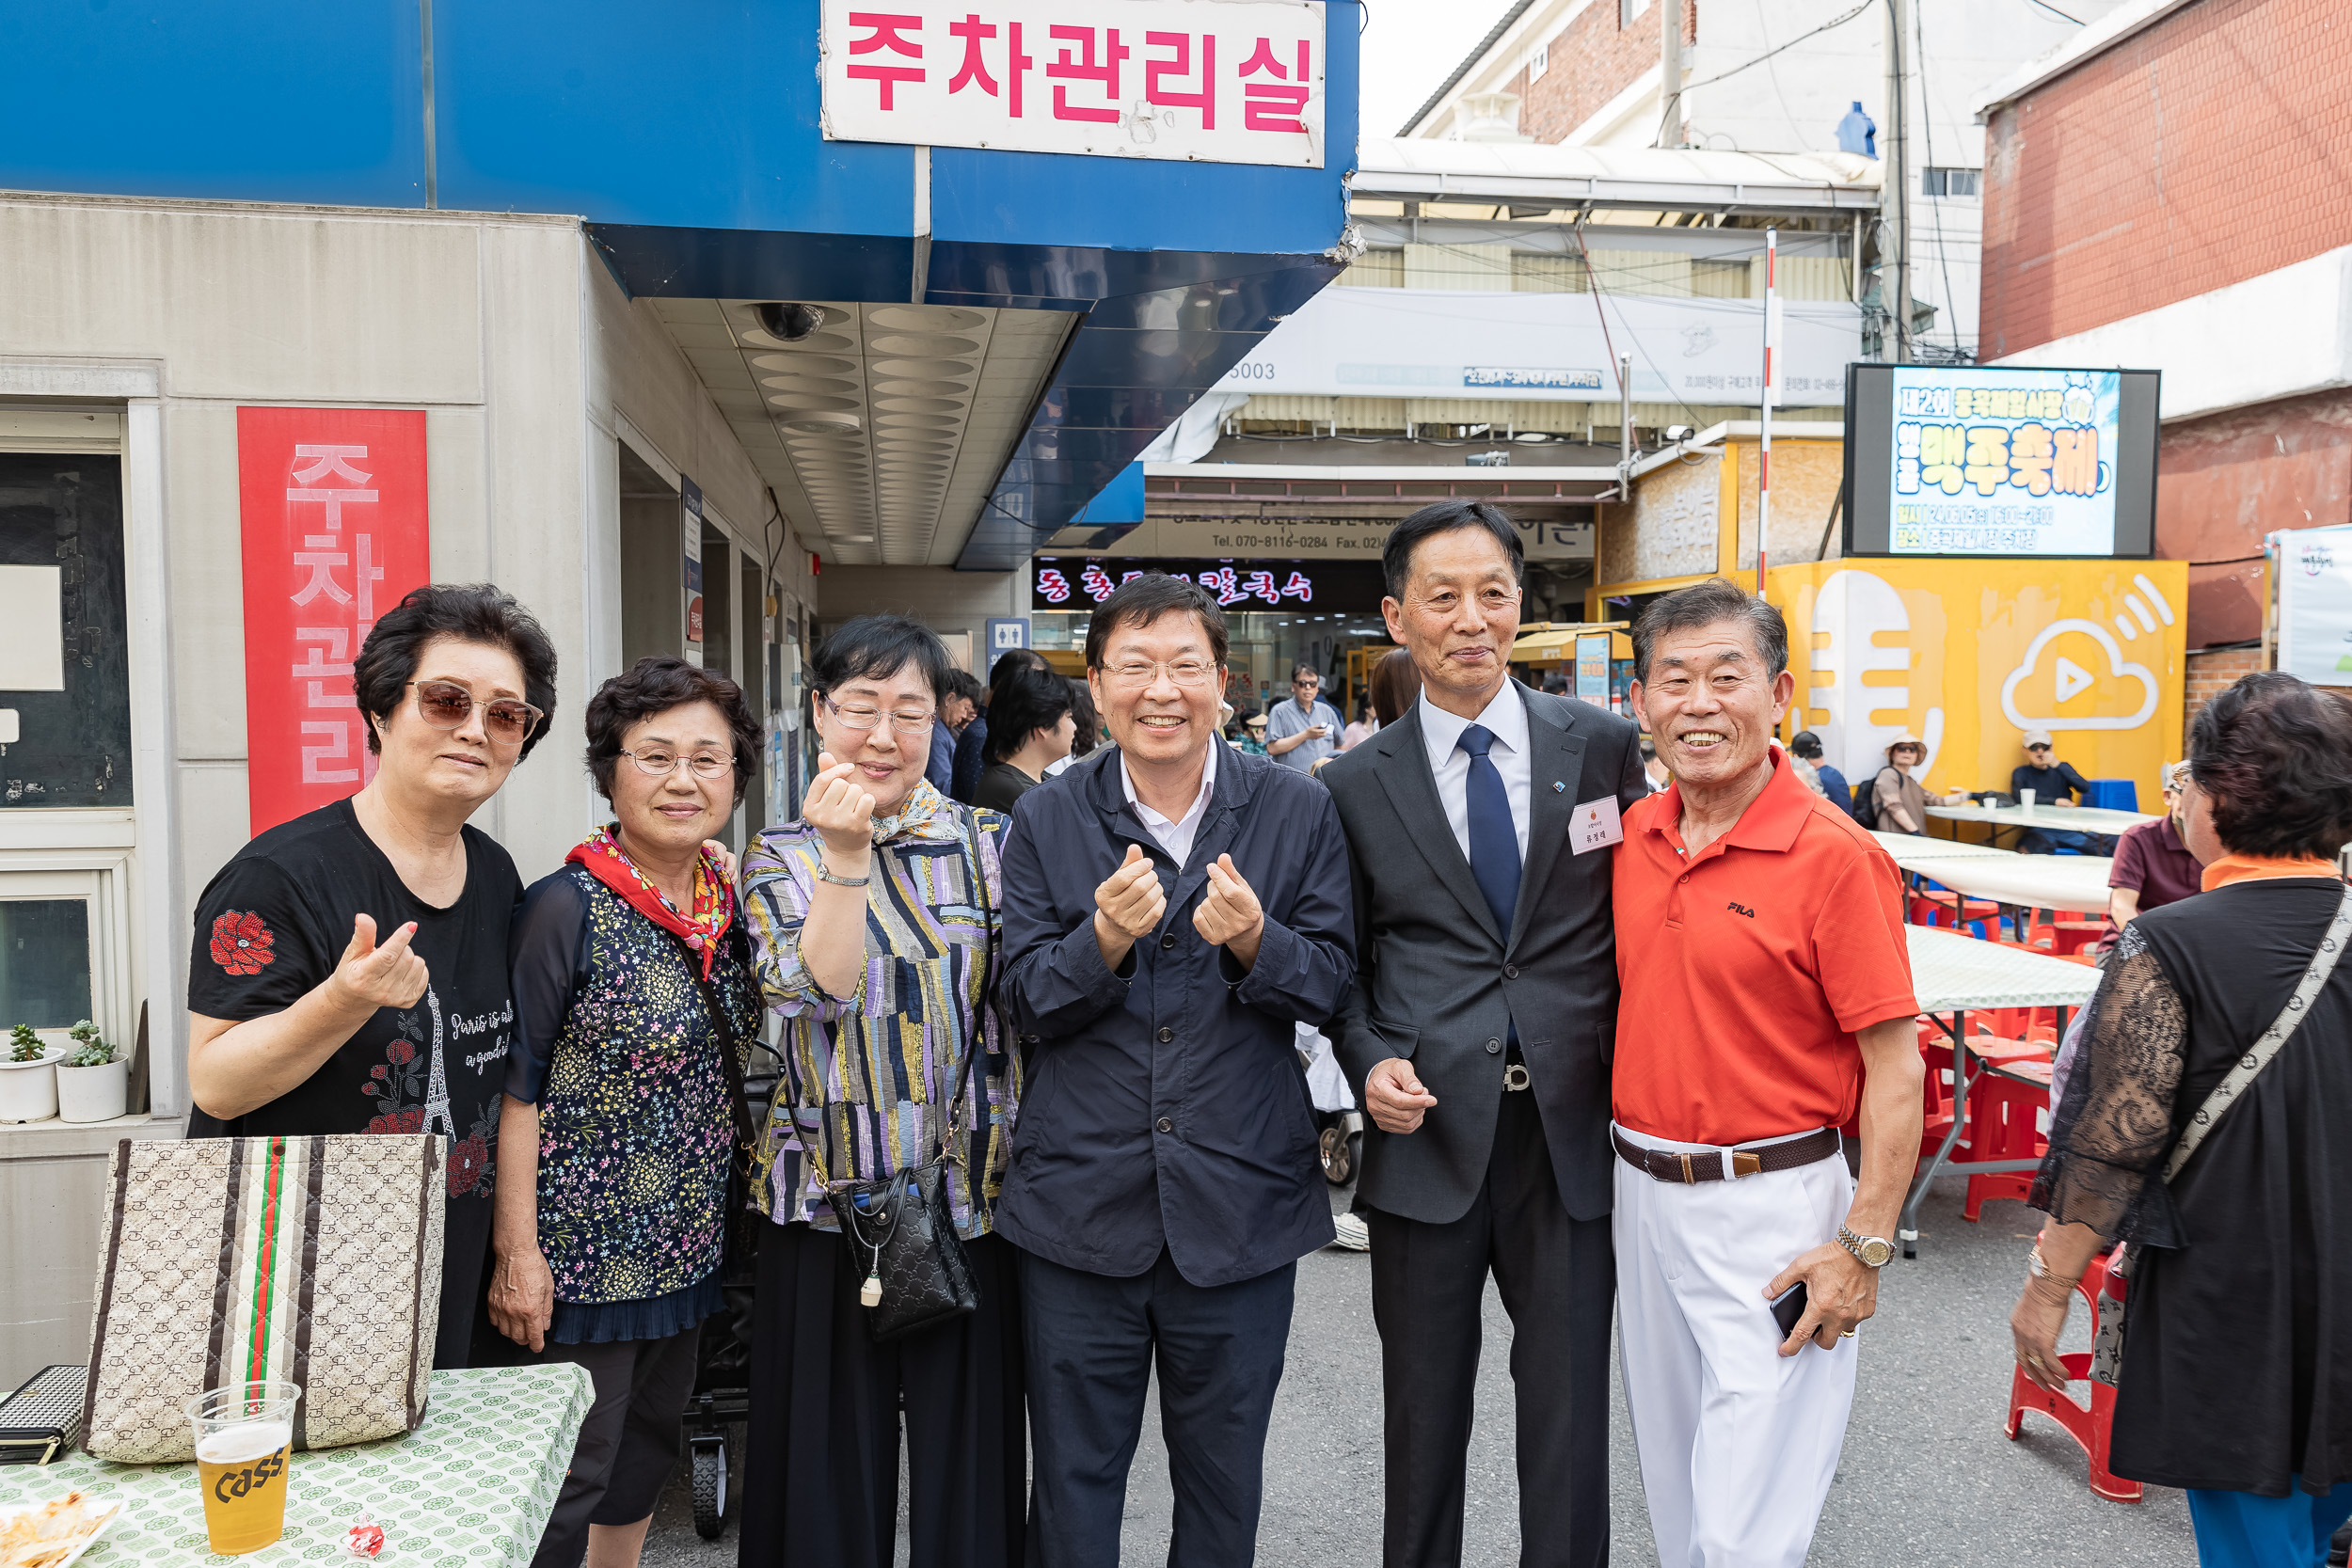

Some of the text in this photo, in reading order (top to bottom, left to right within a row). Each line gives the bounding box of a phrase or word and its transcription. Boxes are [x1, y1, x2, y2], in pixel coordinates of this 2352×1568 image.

[847, 12, 1311, 134] 주차관리실
[1900, 388, 2064, 420] 제2회 중곡제일시장
[1920, 421, 2099, 497] 맥주축제
[1213, 535, 1232, 546] Tel.
[1236, 535, 1328, 548] 070-8116-0284
[1336, 537, 1360, 548] Fax.
[287, 444, 384, 809] 주차관리
[1727, 901, 1755, 918] FILA
[452, 1013, 487, 1040] Paris
[488, 1011, 501, 1029] is
[465, 1054, 476, 1068] a
[476, 1035, 501, 1076] good
